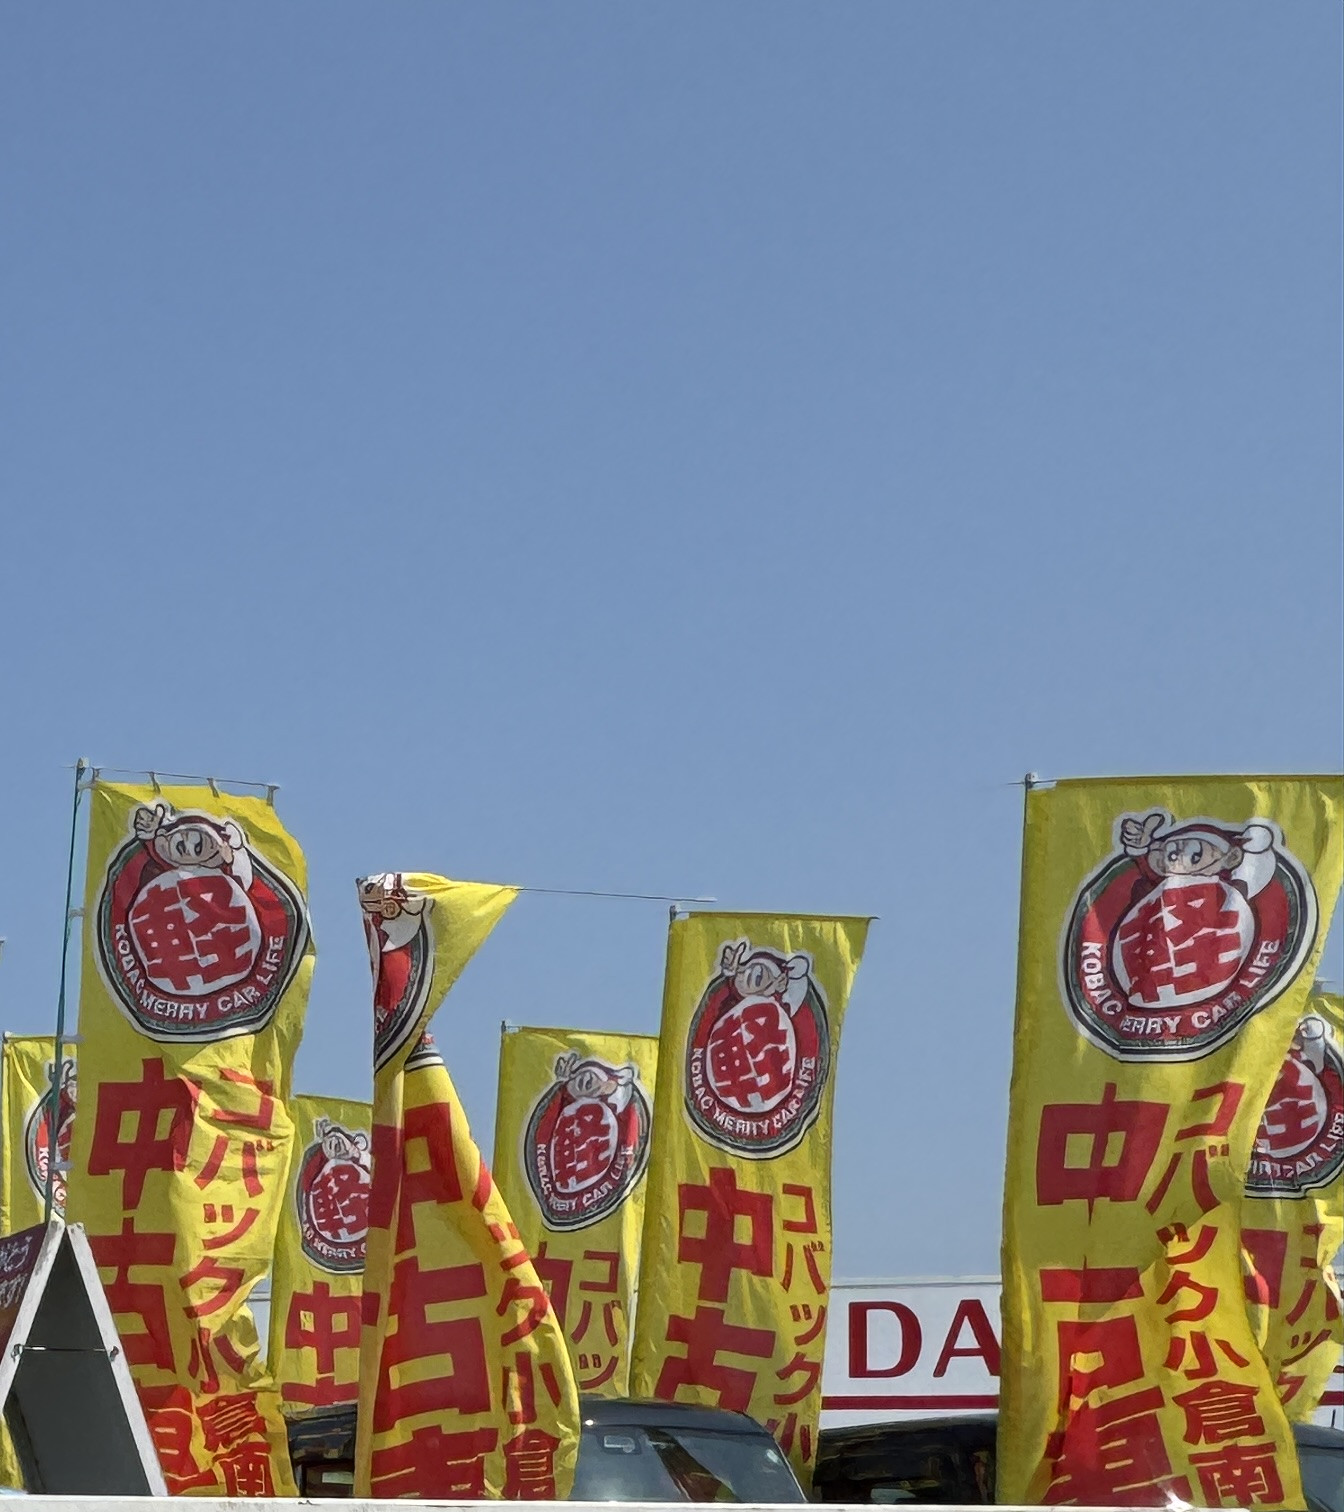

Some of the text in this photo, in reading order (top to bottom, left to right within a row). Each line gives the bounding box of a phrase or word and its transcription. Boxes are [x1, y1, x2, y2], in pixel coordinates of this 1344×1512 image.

[132, 875, 252, 991] 軽
[218, 986, 260, 1012] CAR
[257, 935, 285, 986] LIFE
[1119, 883, 1242, 1003] 軽
[1081, 941, 1122, 1015] KOBAC
[1120, 1015, 1182, 1034] ERRY
[1239, 940, 1280, 988] LIFE
[711, 1003, 794, 1108] 軽
[849, 1299, 1002, 1378] DA
[1145, 1081, 1285, 1506] コバック小倉南
